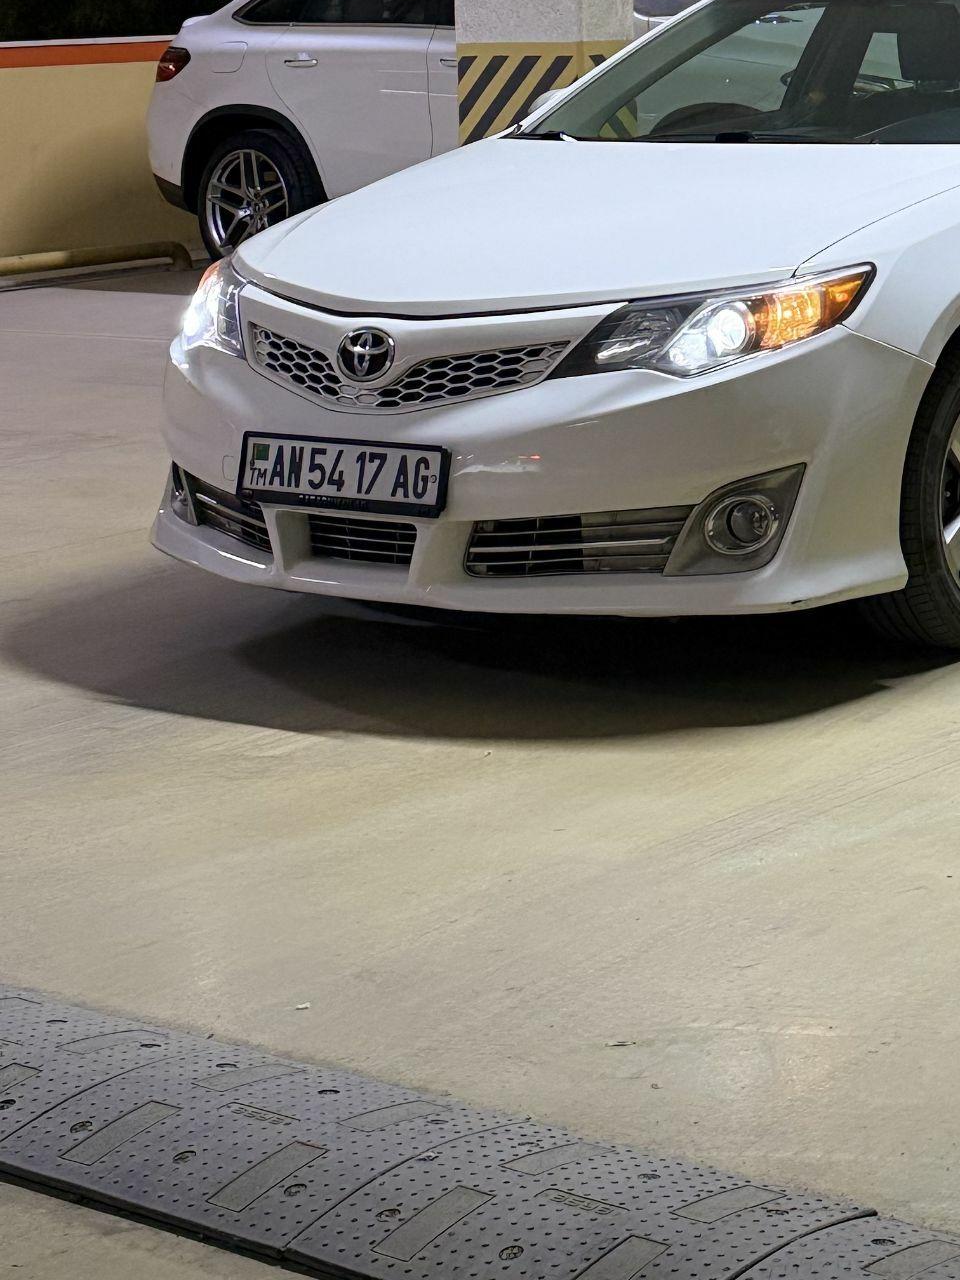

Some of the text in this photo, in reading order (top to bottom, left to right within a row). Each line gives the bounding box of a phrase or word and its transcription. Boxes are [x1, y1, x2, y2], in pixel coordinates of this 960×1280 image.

[250, 467, 267, 486] TM
[269, 445, 430, 499] AN 54 17 AG
